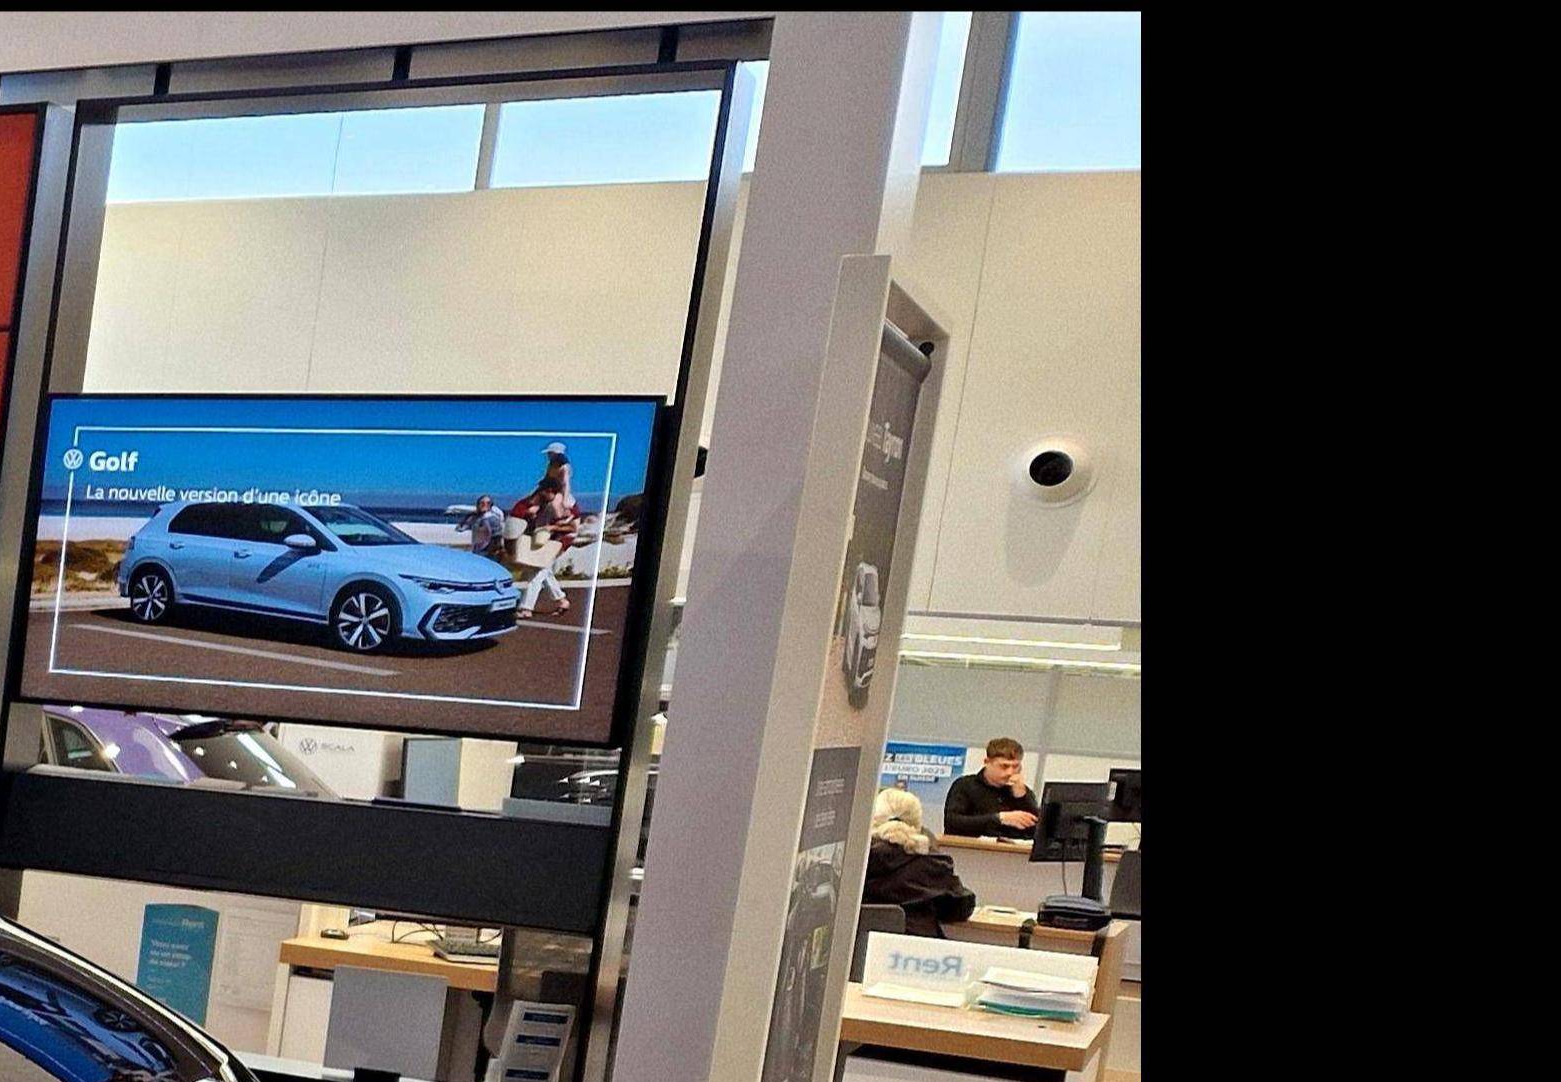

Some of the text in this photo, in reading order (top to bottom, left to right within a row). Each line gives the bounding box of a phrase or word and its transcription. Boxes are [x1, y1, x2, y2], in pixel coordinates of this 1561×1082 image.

[89, 451, 139, 472] Golf
[86, 484, 342, 506] La nouvelle version d'une icône
[914, 754, 962, 766] BLEUES
